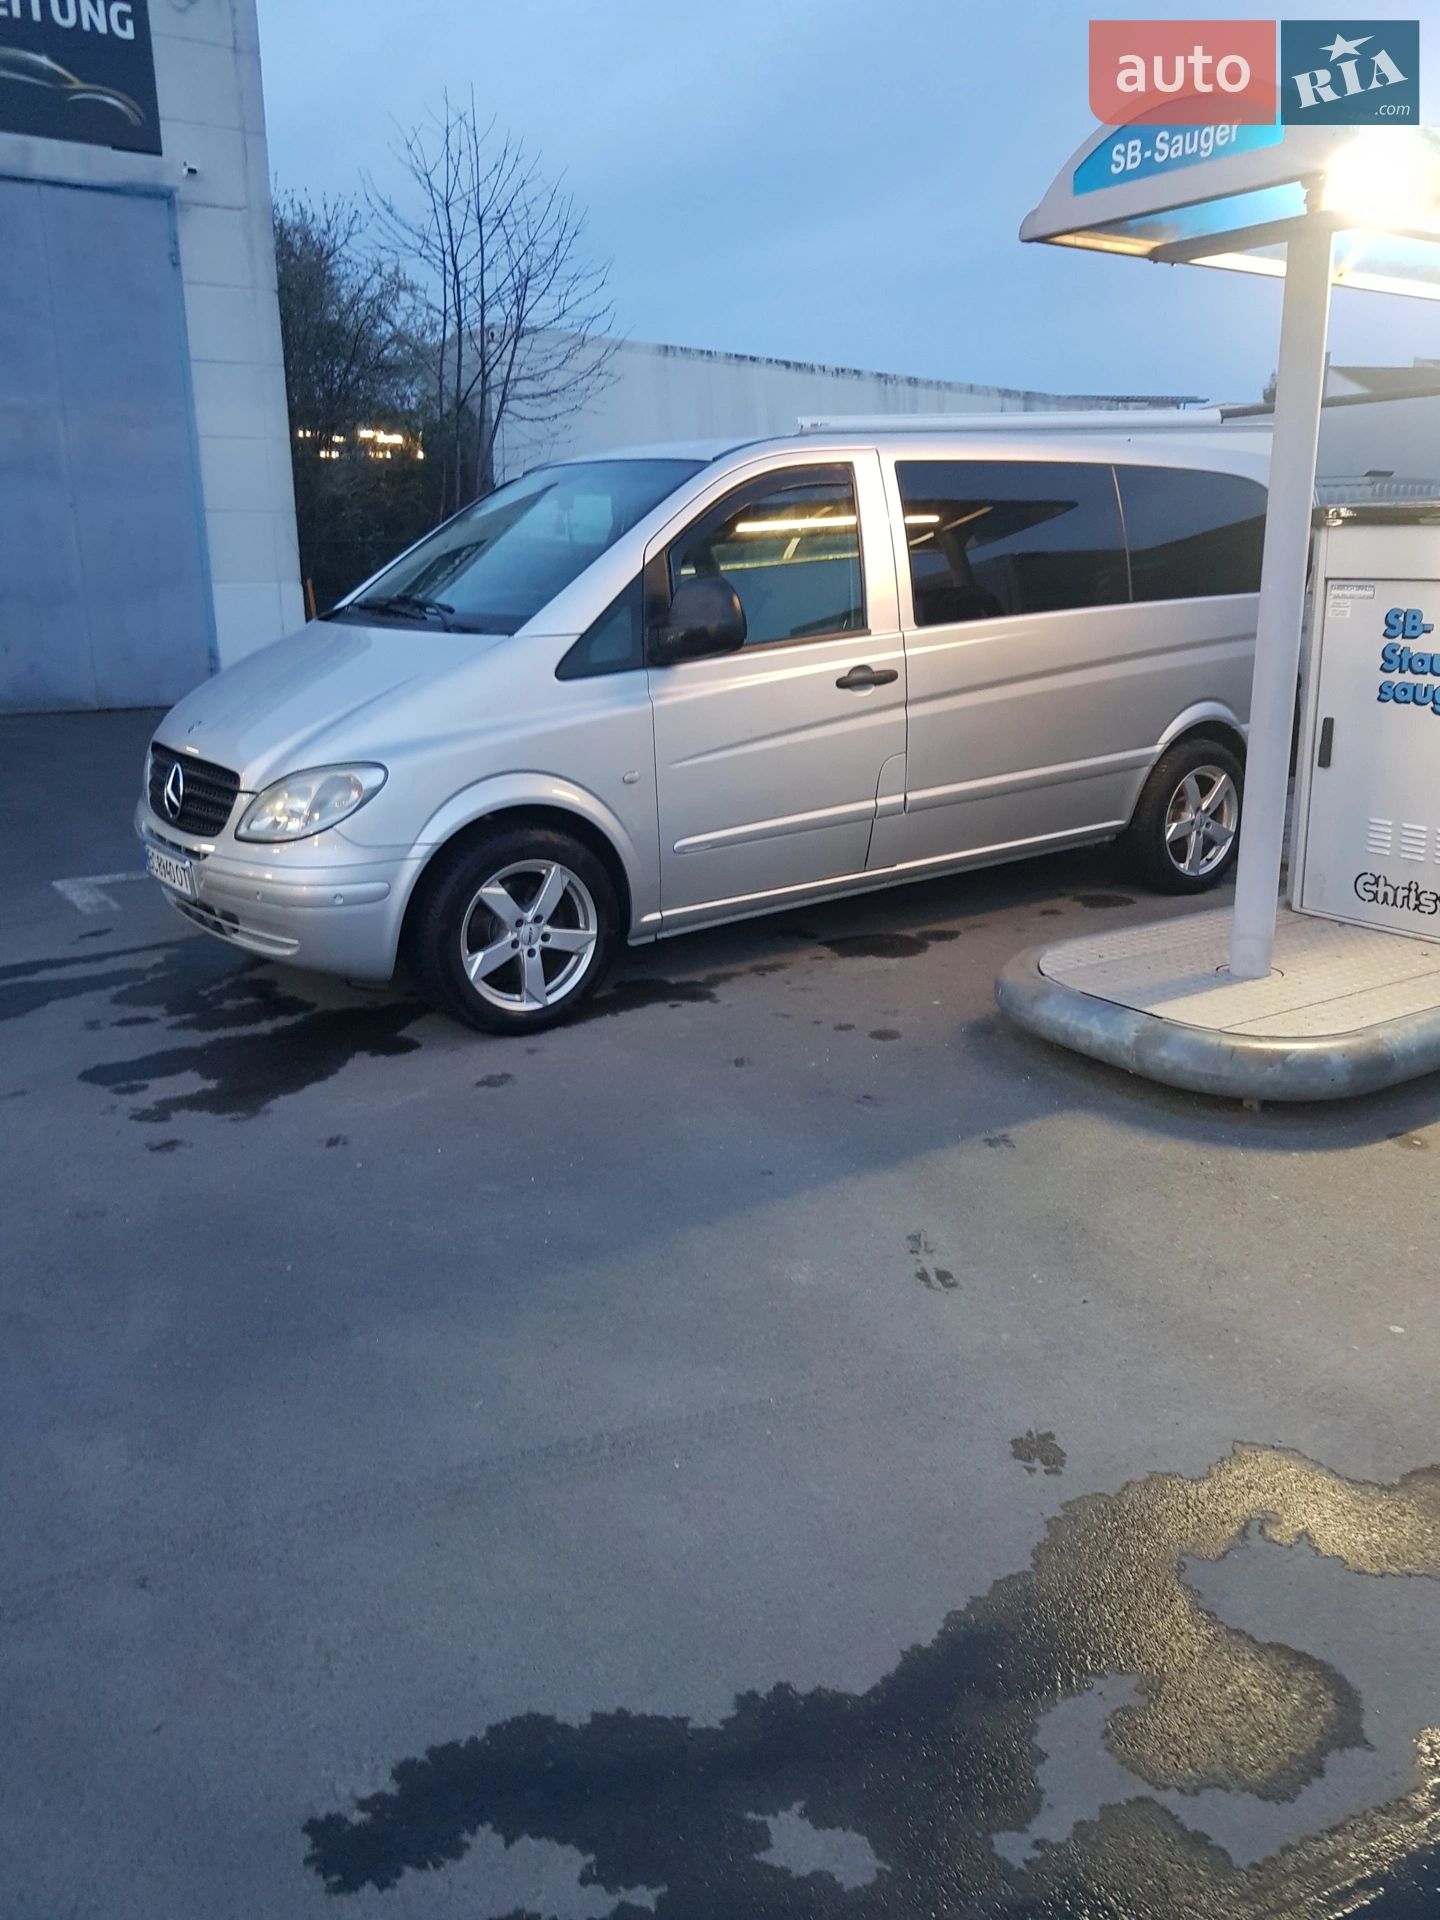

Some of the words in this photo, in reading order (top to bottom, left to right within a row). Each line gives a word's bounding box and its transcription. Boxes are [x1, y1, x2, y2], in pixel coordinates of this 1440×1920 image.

[1110, 118, 1243, 175] SB-Sauger
[1383, 607, 1434, 640] SB-
[1354, 871, 1440, 915] Chris
